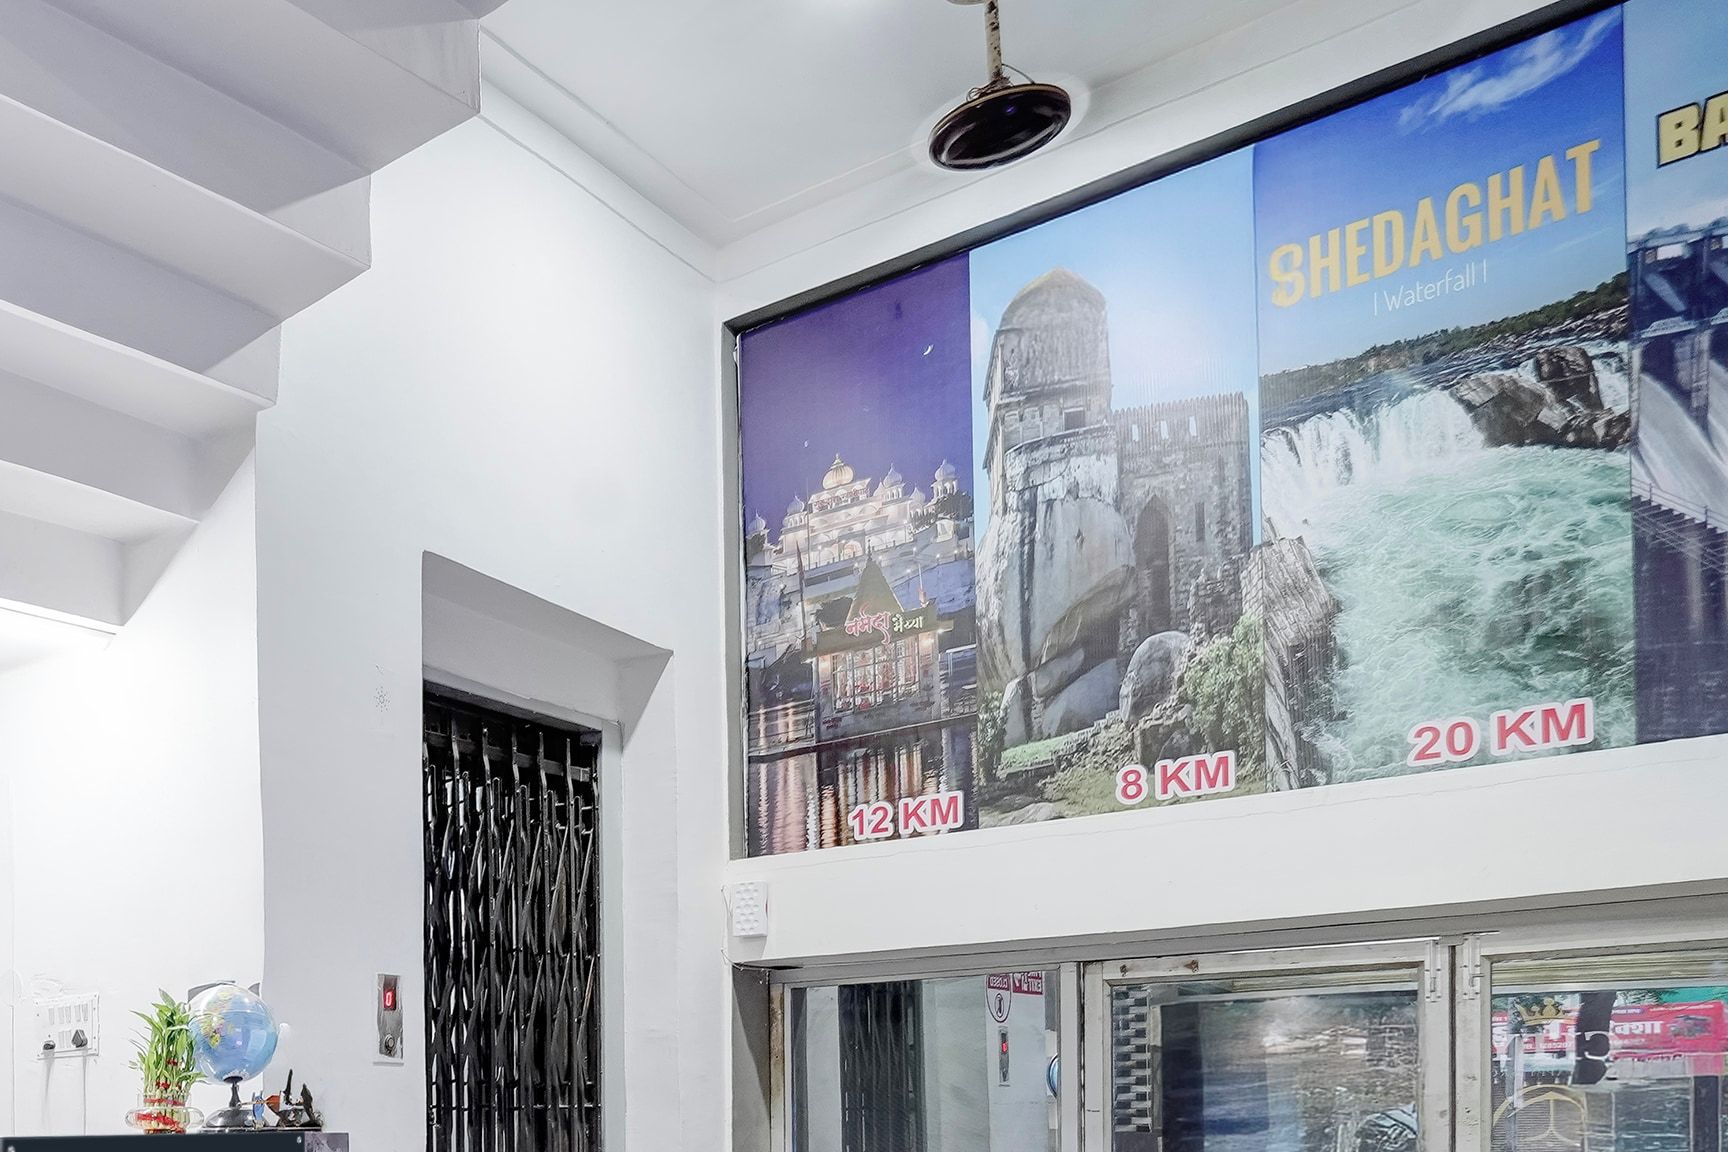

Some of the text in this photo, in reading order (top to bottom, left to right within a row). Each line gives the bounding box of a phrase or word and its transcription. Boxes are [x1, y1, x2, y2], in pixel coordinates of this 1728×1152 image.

[1382, 261, 1477, 312] Waterfall
[1412, 702, 1588, 763] 20 KM
[1120, 755, 1232, 801] 8 KM
[850, 794, 961, 836] 12 KM
